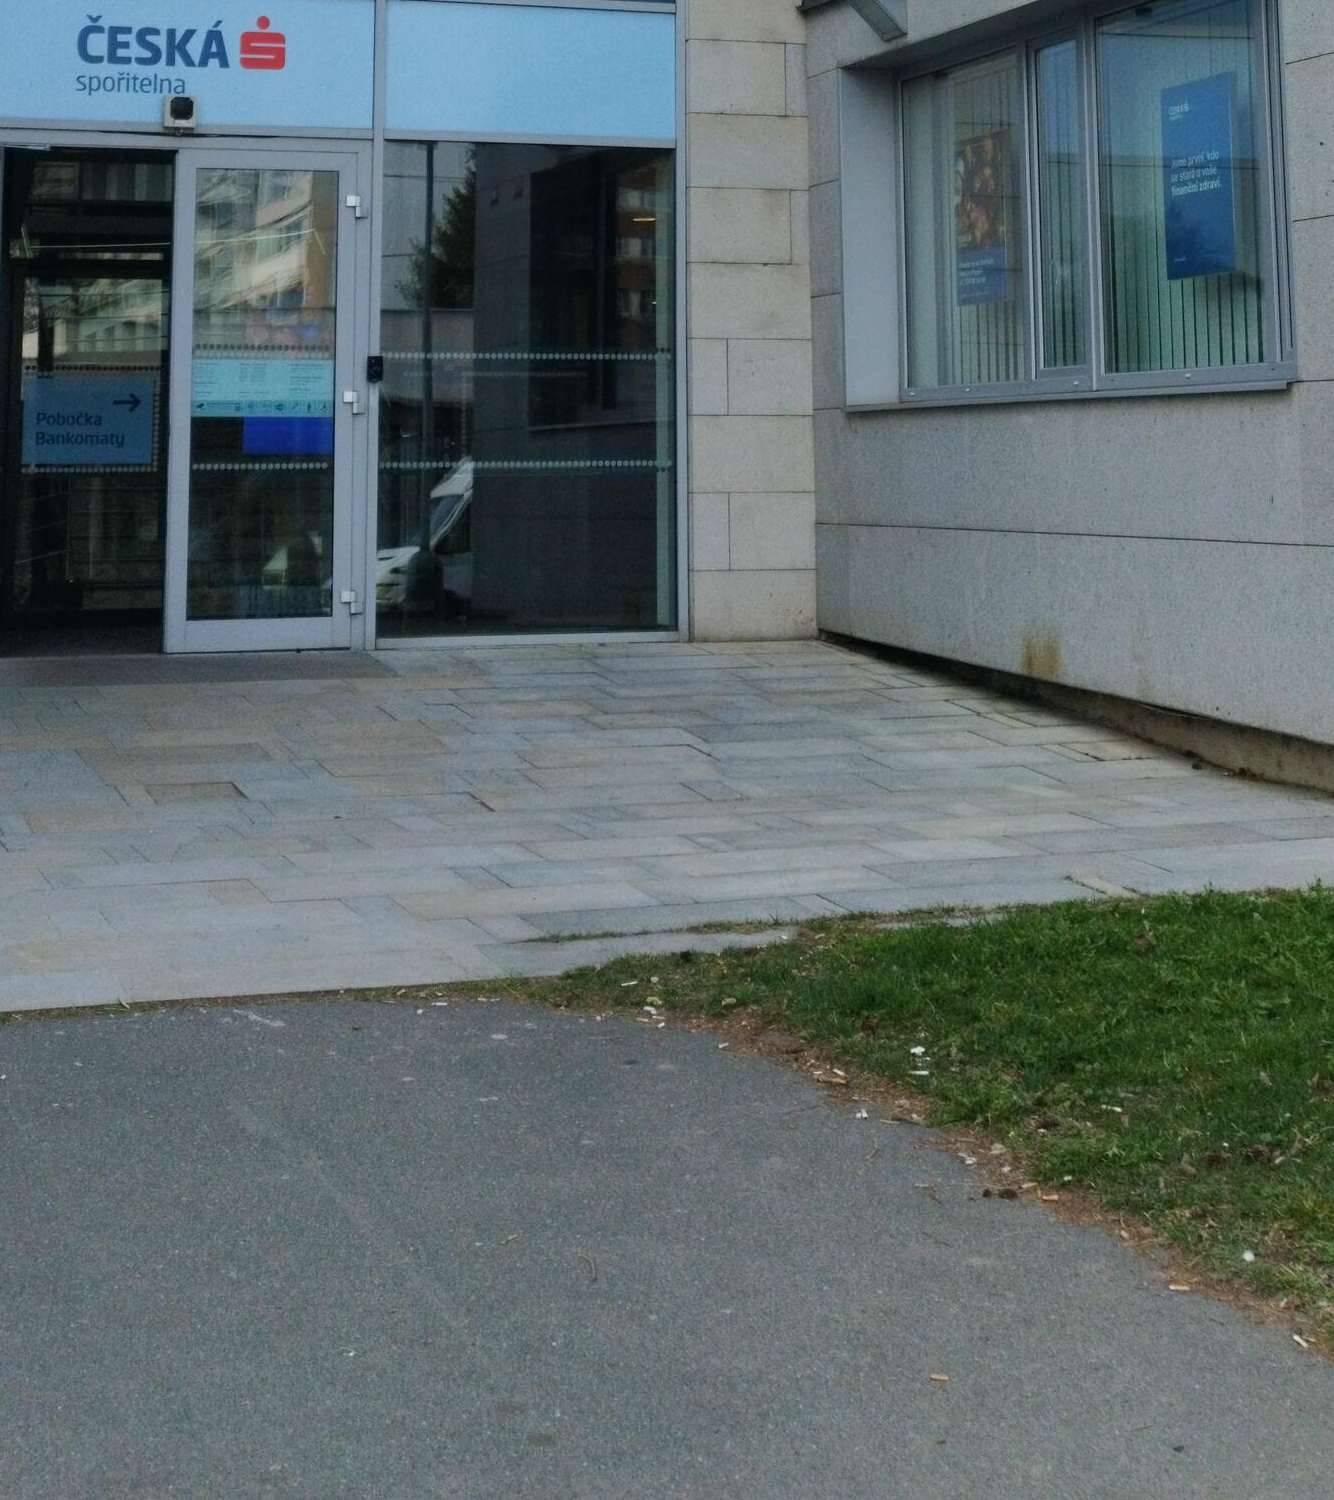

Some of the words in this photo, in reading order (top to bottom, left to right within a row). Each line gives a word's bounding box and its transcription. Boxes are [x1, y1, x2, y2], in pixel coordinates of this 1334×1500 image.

[77, 14, 230, 69] ČESKÁ
[76, 72, 186, 96] spořitelna
[36, 412, 102, 426] Pobočka
[35, 431, 126, 449] Bankomaty
